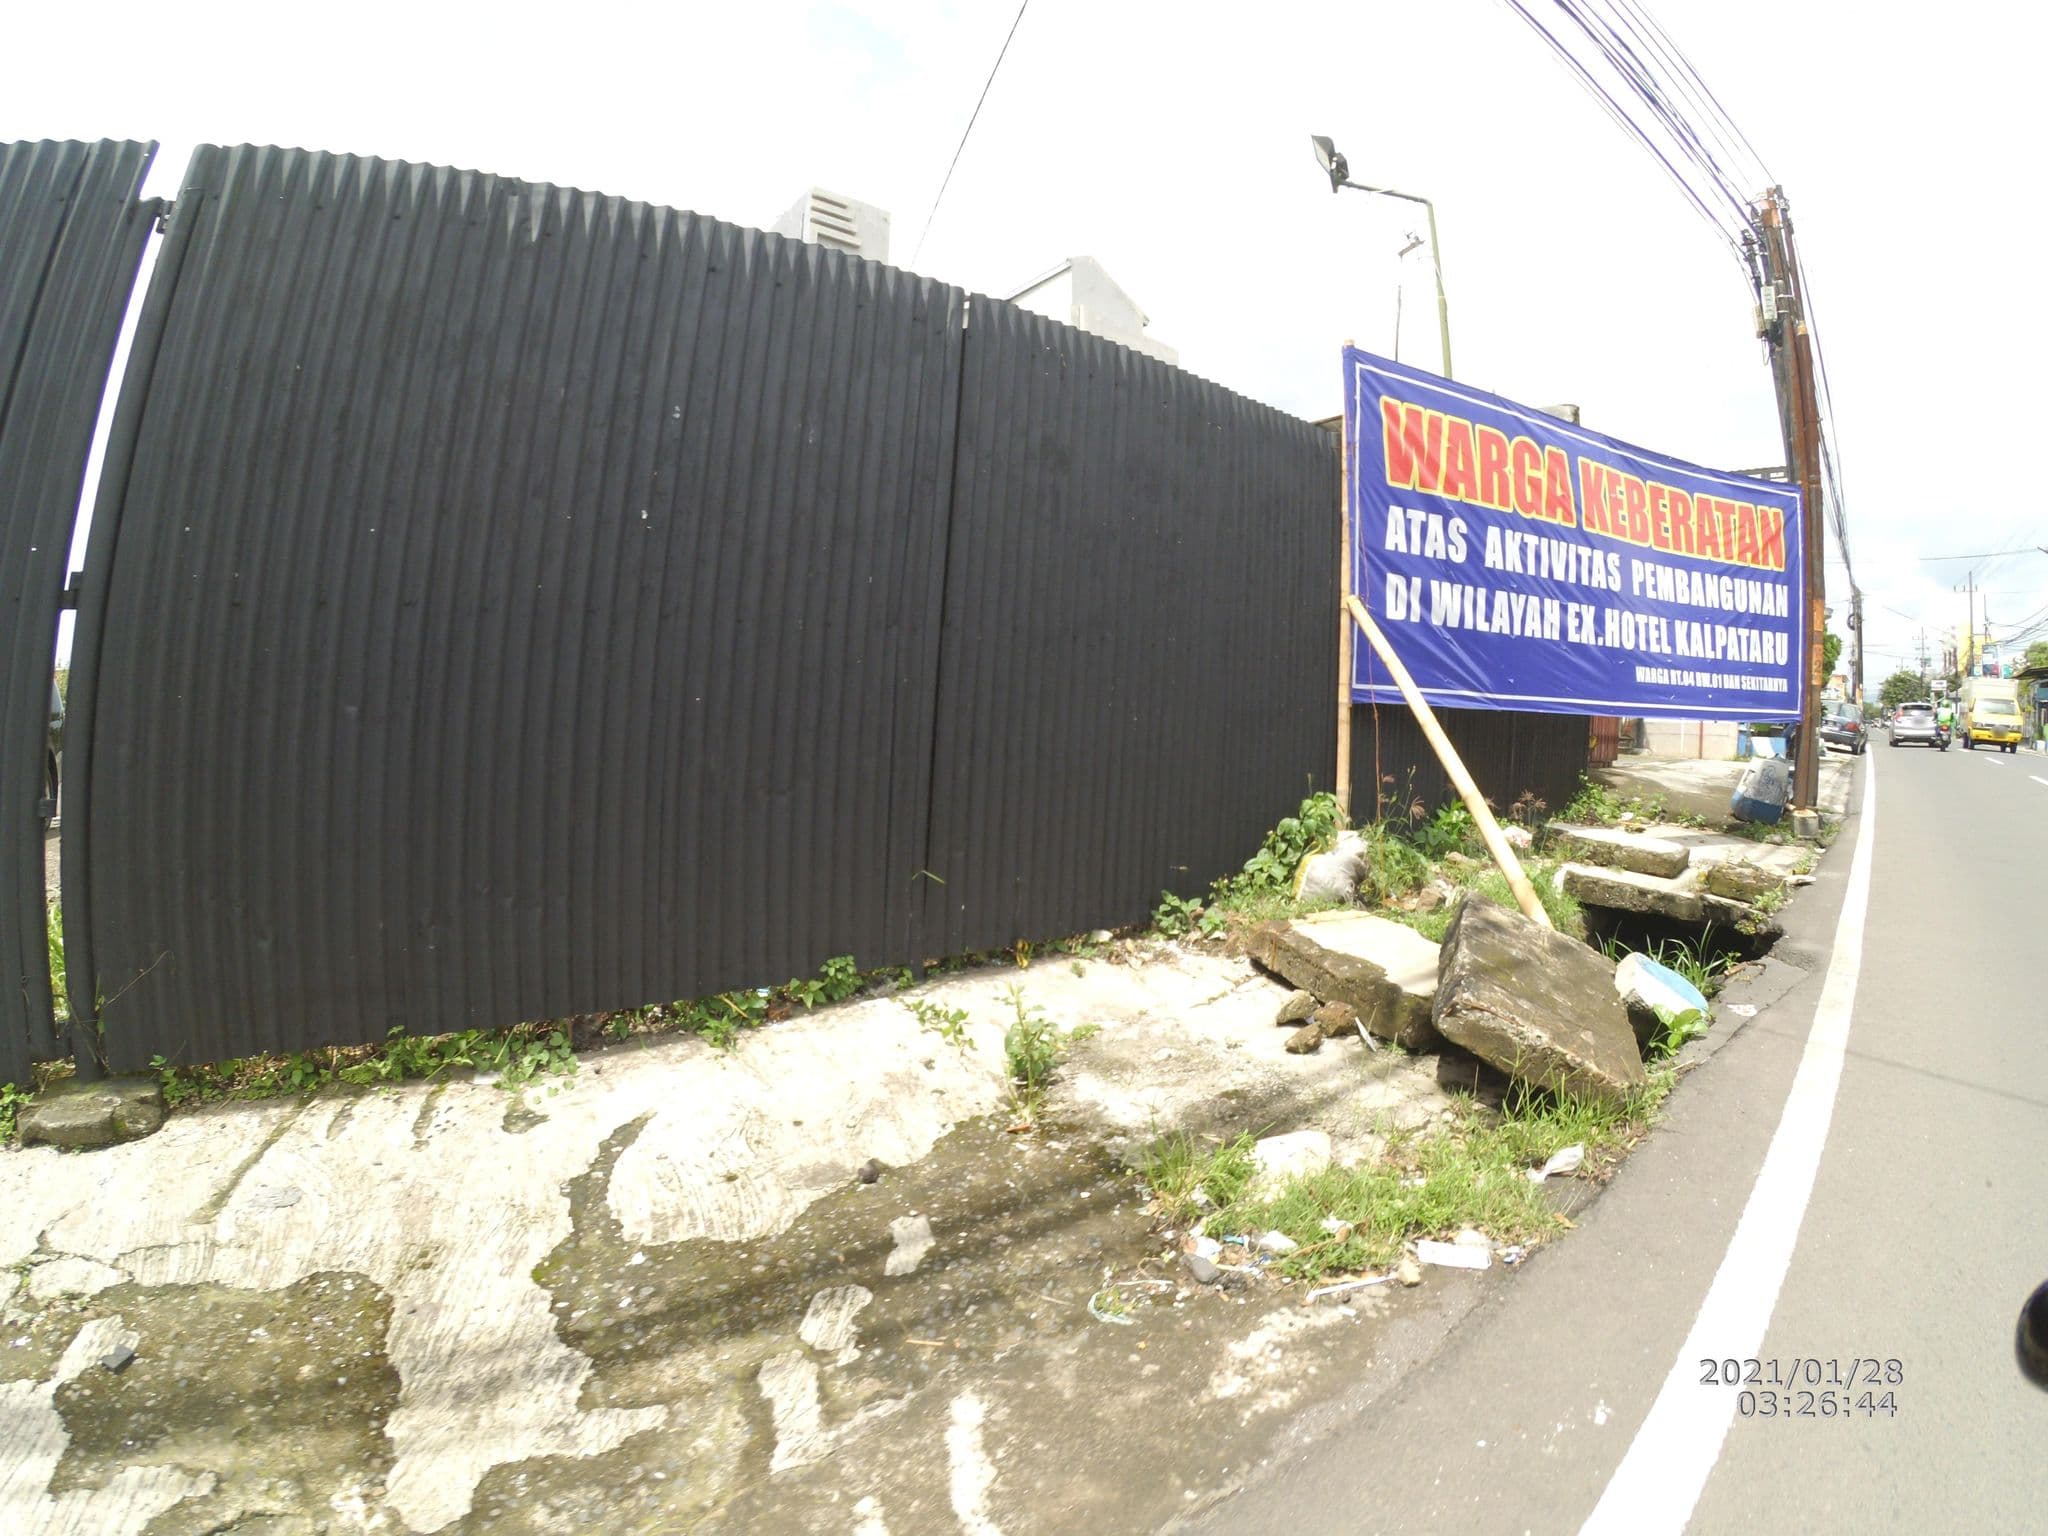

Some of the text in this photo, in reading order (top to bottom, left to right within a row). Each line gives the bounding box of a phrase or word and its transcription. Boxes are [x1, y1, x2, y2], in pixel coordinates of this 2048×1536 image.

[1380, 395, 1786, 572] WARGA KEBERATAN
[1385, 505, 1789, 618] ATAS AKTIVITAS PEMBANGUNAN
[1385, 573, 1421, 623] DI
[1430, 579, 1560, 641] WILAYAH
[1676, 621, 1789, 666] KALPATARU
[1635, 666, 1670, 685] WARGA
[1723, 673, 1741, 690] DAN
[1741, 675, 1788, 693] SEKITARNYA
